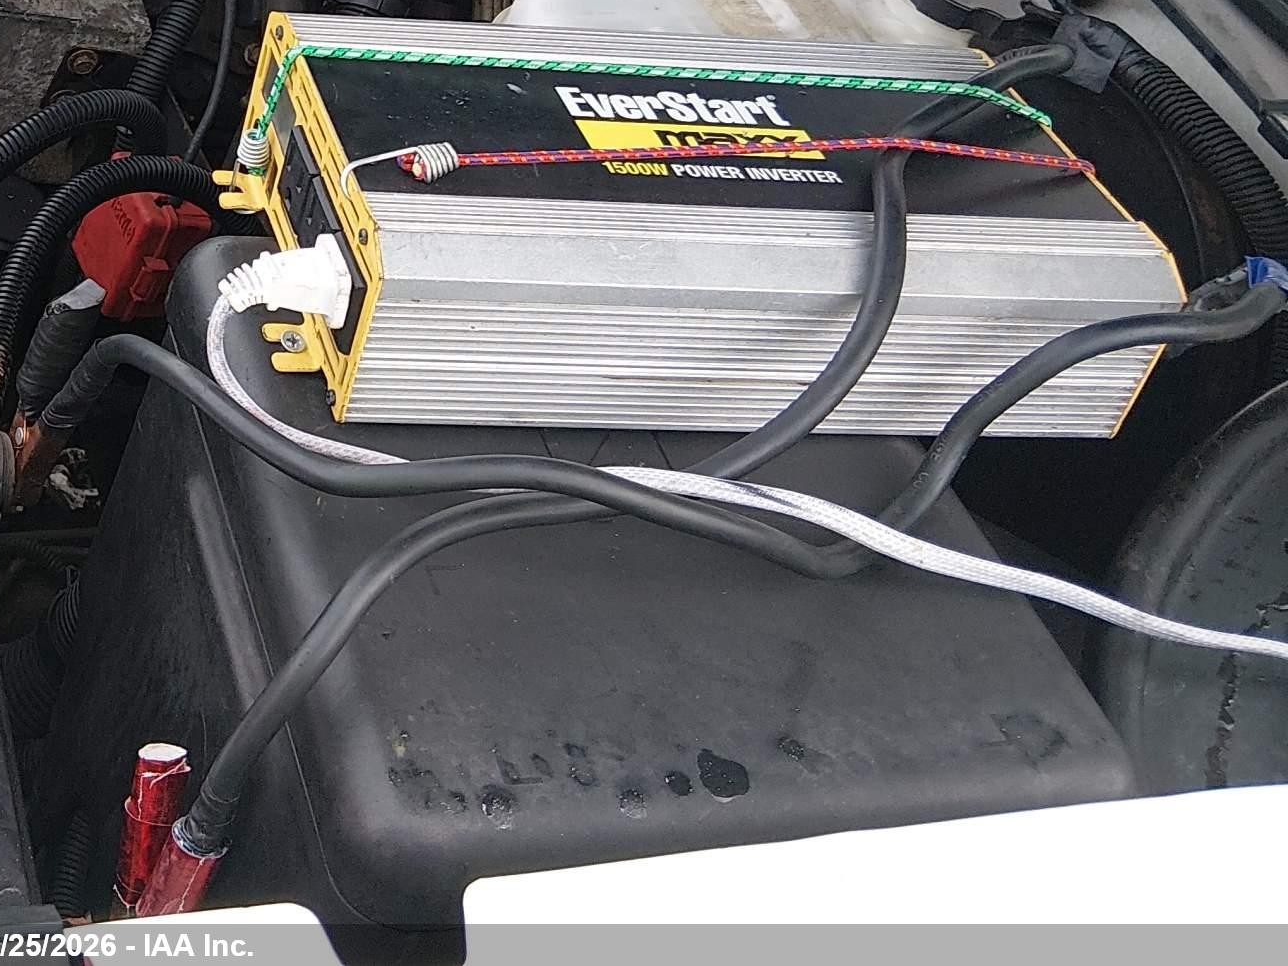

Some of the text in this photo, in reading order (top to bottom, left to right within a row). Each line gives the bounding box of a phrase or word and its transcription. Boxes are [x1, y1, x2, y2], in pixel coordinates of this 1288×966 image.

[602, 161, 843, 184] 1500W POWER INVERTER
